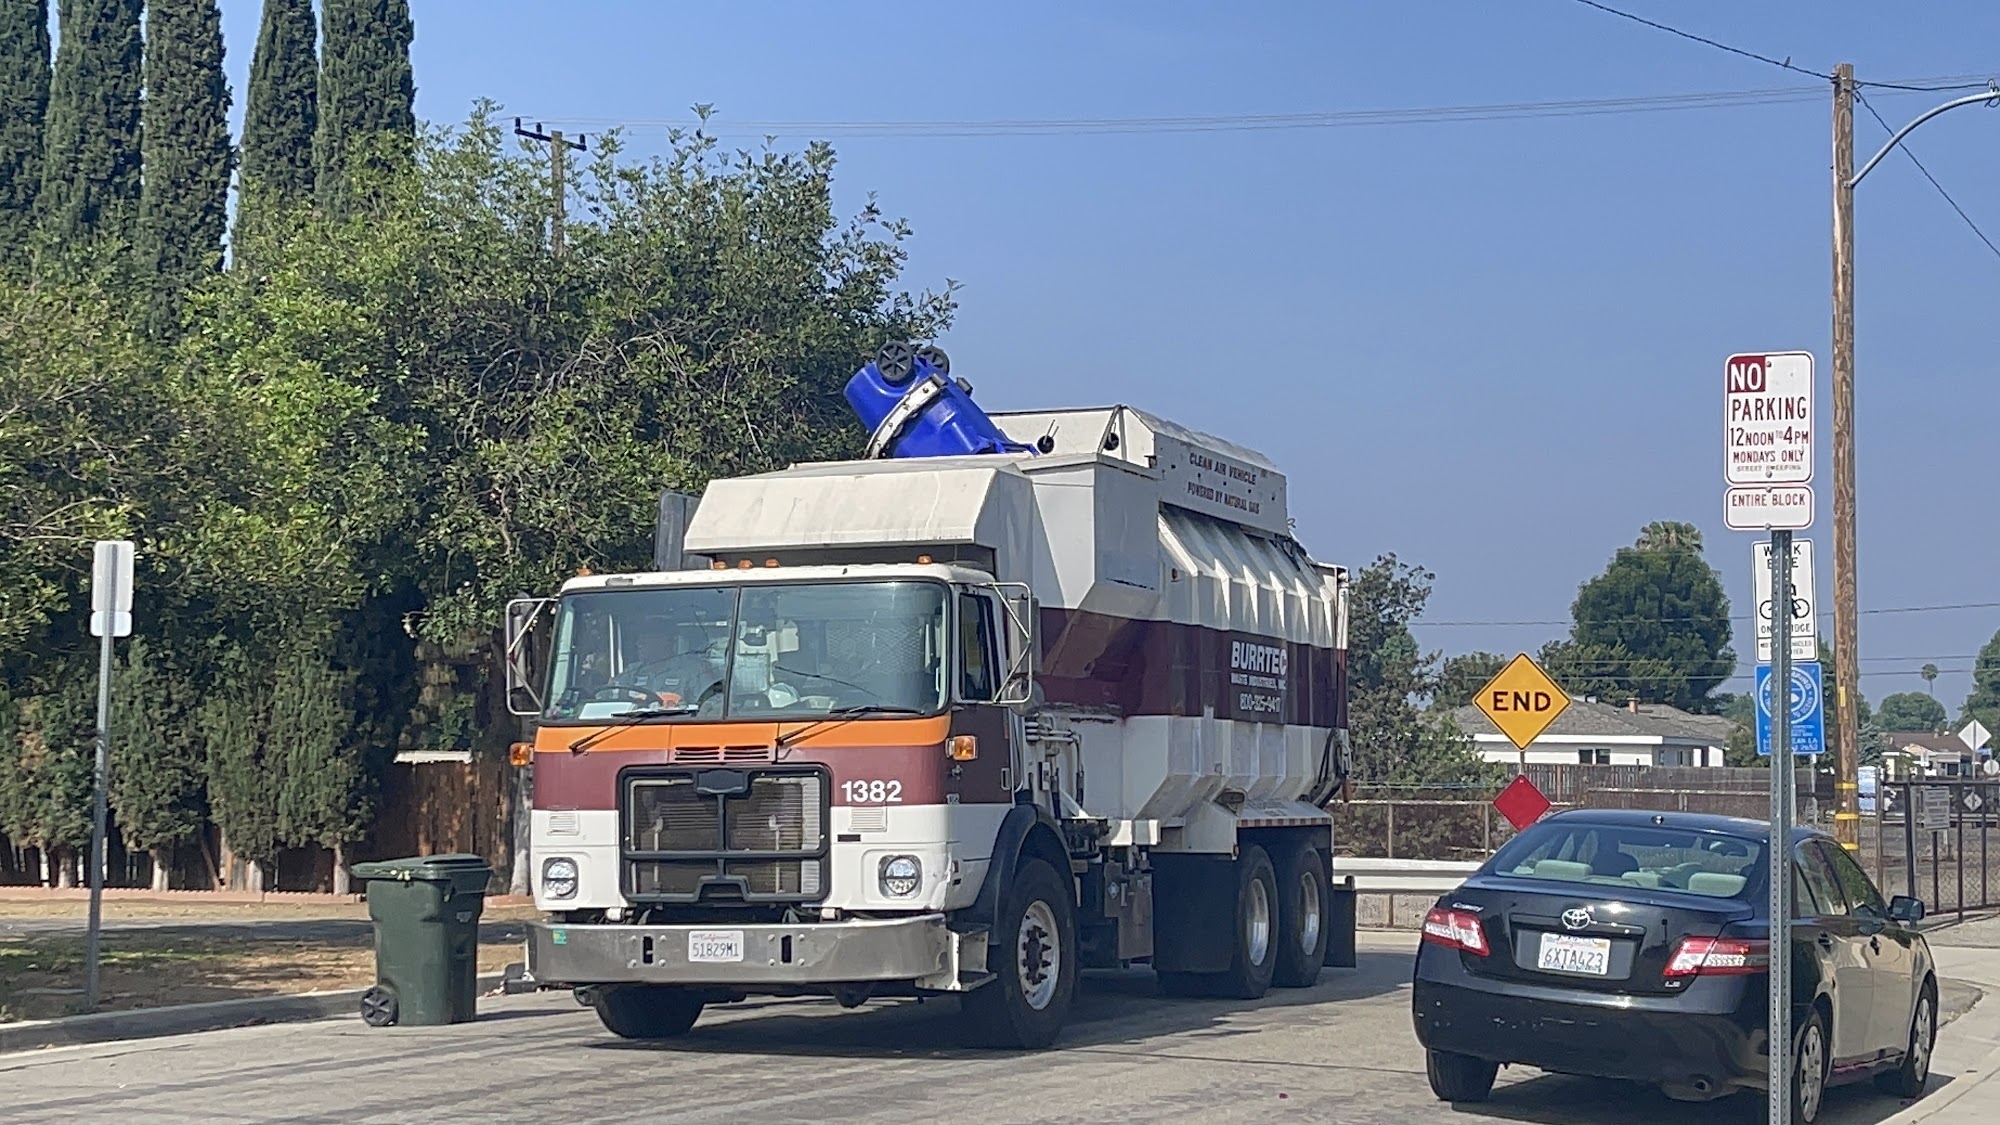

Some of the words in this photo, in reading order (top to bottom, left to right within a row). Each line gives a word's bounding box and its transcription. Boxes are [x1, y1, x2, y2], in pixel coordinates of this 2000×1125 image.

[1730, 362, 1762, 391] NO
[1731, 396, 1807, 421] PARKING
[1733, 450, 1776, 463] MONDAYS
[1781, 449, 1804, 462] ONLY
[1189, 452, 1212, 470] CLEAN
[1214, 461, 1226, 475] AIR
[1229, 465, 1256, 485] VEHICLE
[1187, 481, 1214, 500] POWERED
[1215, 490, 1223, 503] BY
[1224, 493, 1247, 511] NATURAL
[1732, 494, 1767, 506] ENTIRE
[1772, 493, 1806, 505] BLOCK
[1763, 544, 1801, 557] WK
[1767, 557, 1799, 569] BE
[1231, 640, 1288, 676] BURRTEC
[1493, 691, 1551, 711] END
[841, 780, 902, 802] 1382
[692, 942, 739, 957] 51829M1
[1544, 947, 1604, 968] 6XTA423
